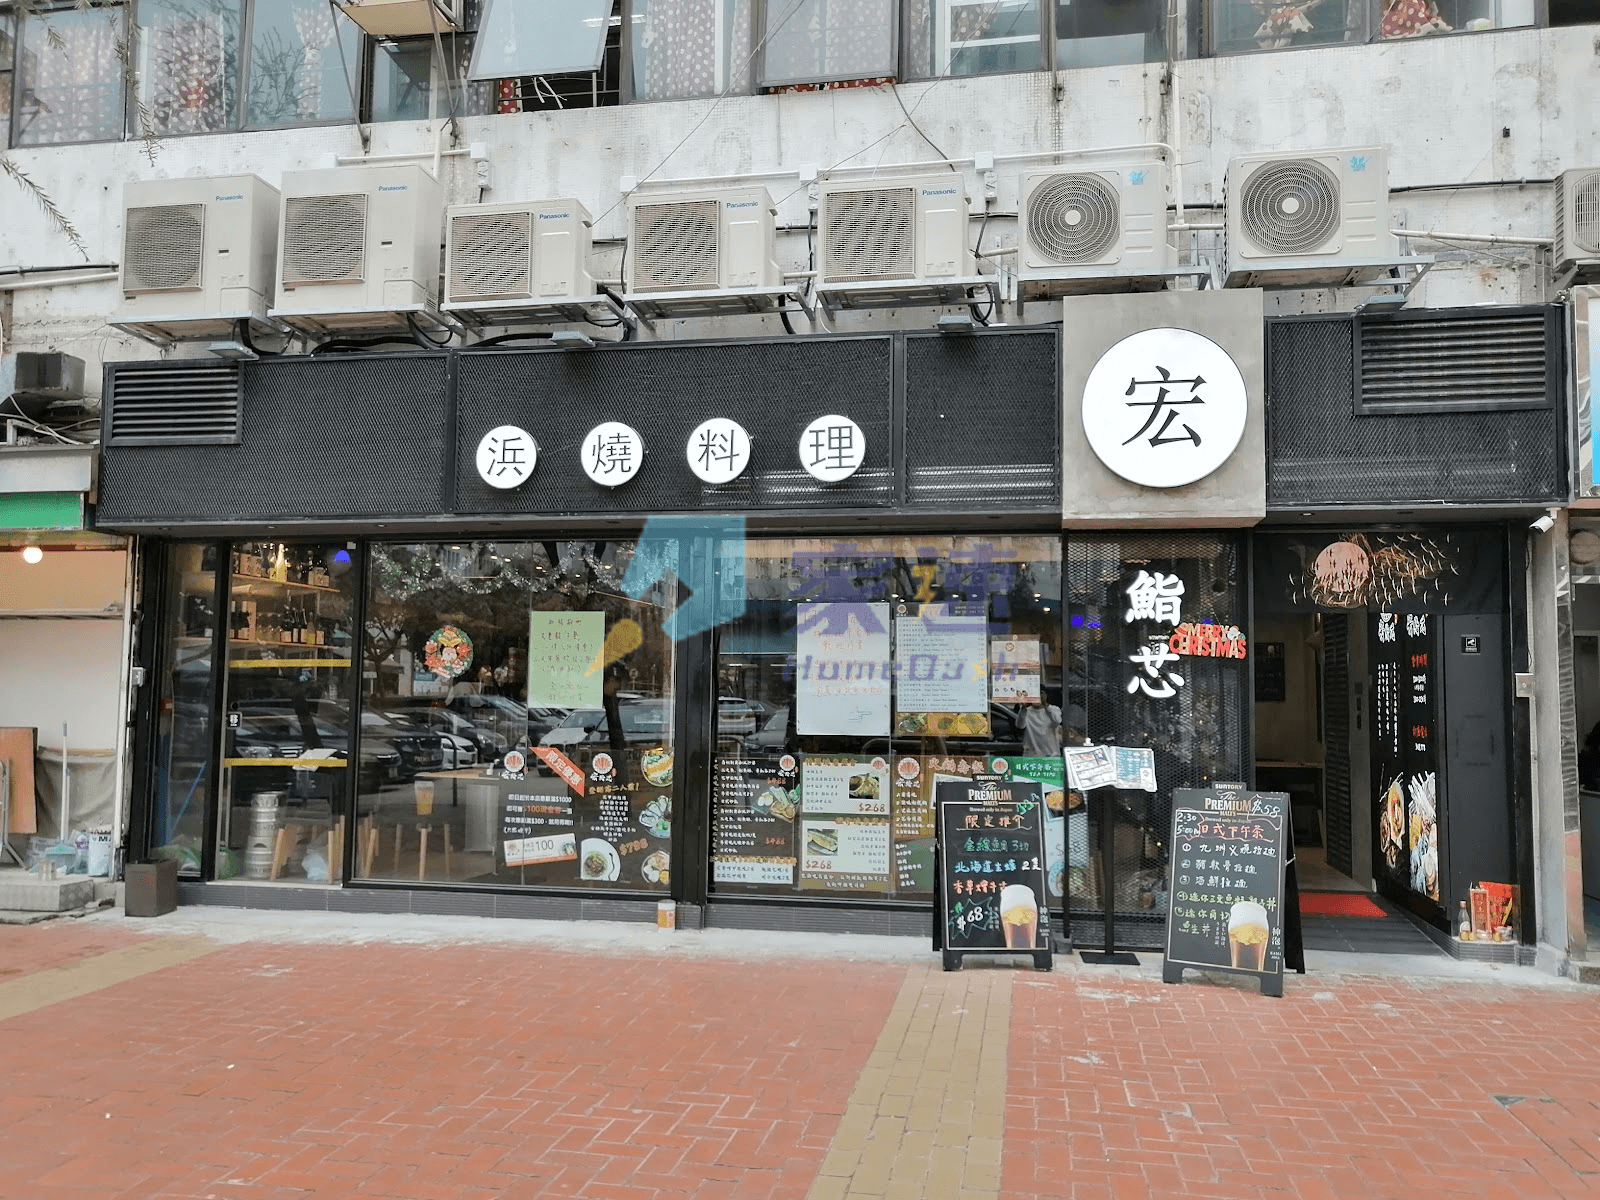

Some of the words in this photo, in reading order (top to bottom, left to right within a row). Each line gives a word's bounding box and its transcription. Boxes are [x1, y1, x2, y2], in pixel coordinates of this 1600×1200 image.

[922, 188, 957, 197] Panasonic
[726, 200, 759, 209] Panasonic
[539, 212, 570, 220] Panasonic
[1121, 365, 1208, 448] 宏
[486, 425, 857, 477] 浜燒料理
[1187, 622, 1230, 642] MERRY
[1169, 634, 1247, 659] CHRISTMAS
[976, 774, 1003, 782] SUNTORY
[967, 788, 1013, 801] PREMIUM
[858, 803, 886, 813] $268
[1204, 798, 1251, 812] PREMIUM
[1251, 799, 1281, 819] $58
[1200, 824, 1264, 840] 日式下午茶
[535, 839, 554, 851] 100
[805, 860, 832, 870] $268
